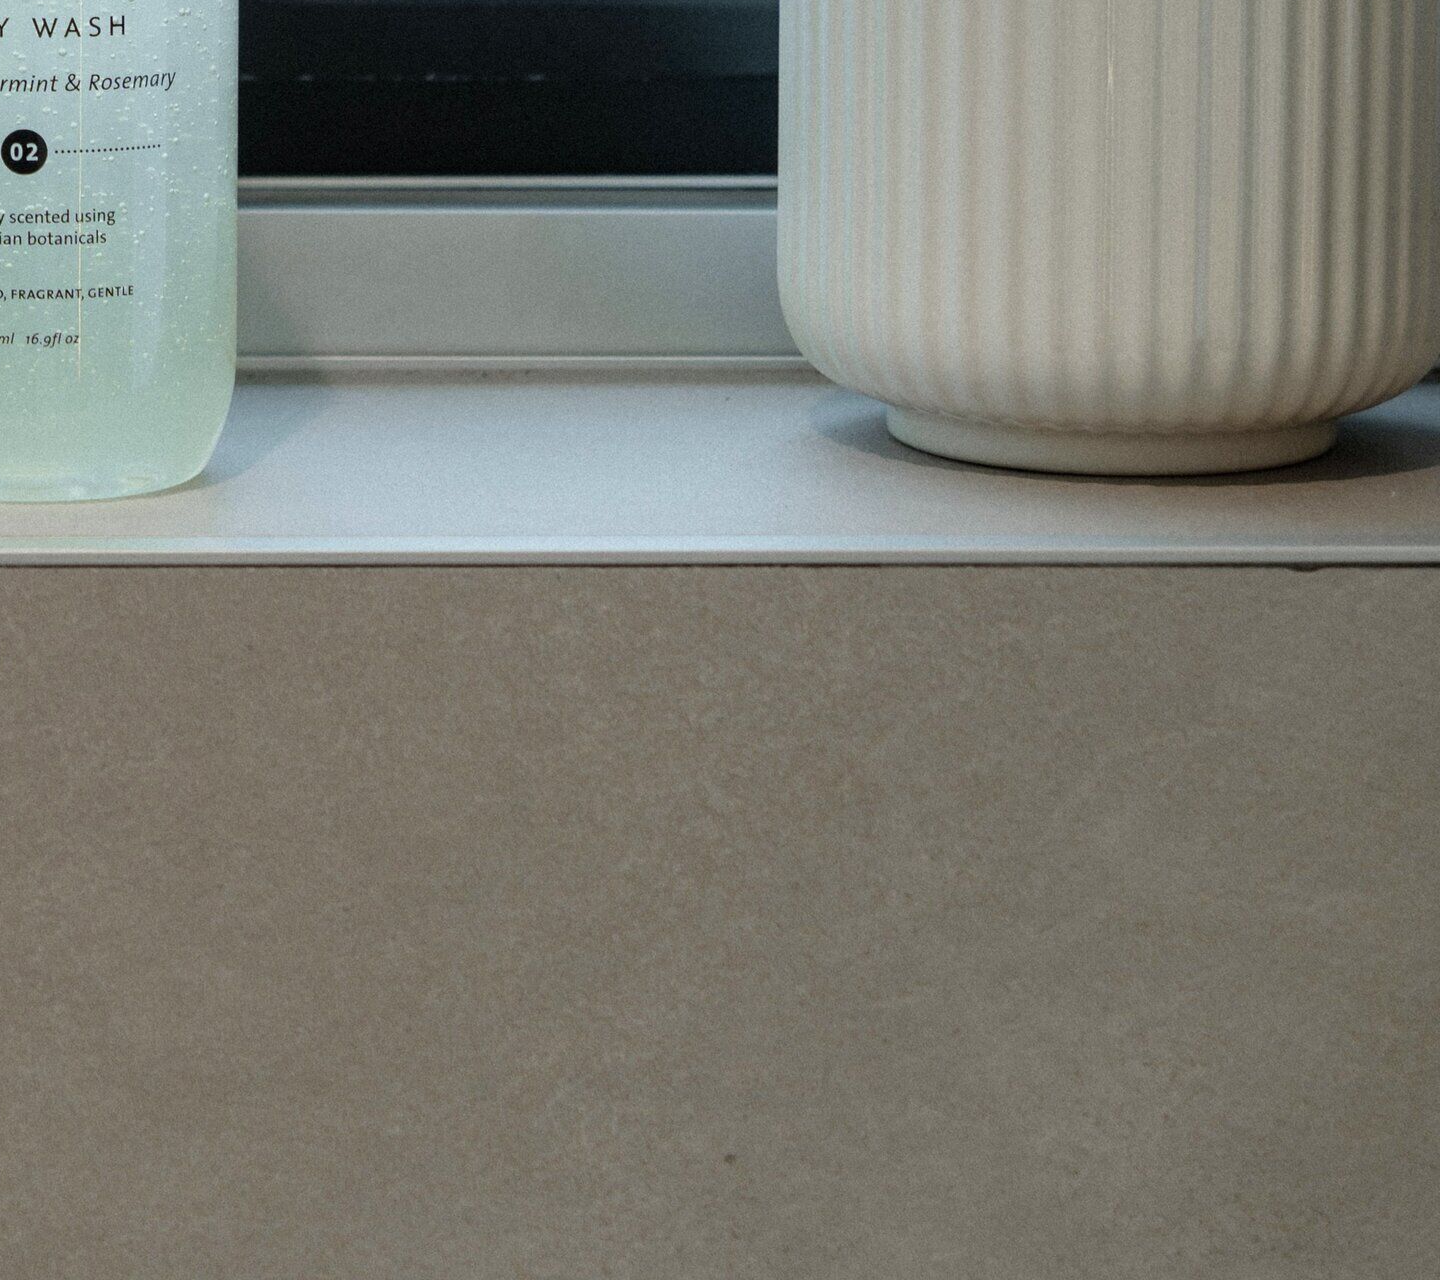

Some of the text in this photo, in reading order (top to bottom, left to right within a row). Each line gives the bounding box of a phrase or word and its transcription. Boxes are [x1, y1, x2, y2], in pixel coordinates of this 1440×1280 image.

[32, 14, 127, 38] WASH
[65, 73, 82, 92] &
[89, 70, 177, 93] Rosemary
[9, 143, 39, 162] 02
[9, 209, 71, 224] scented
[75, 209, 116, 226] using
[26, 230, 108, 246] botanicals
[11, 288, 85, 301] FRAGRANT,
[88, 285, 134, 298] GENTLE
